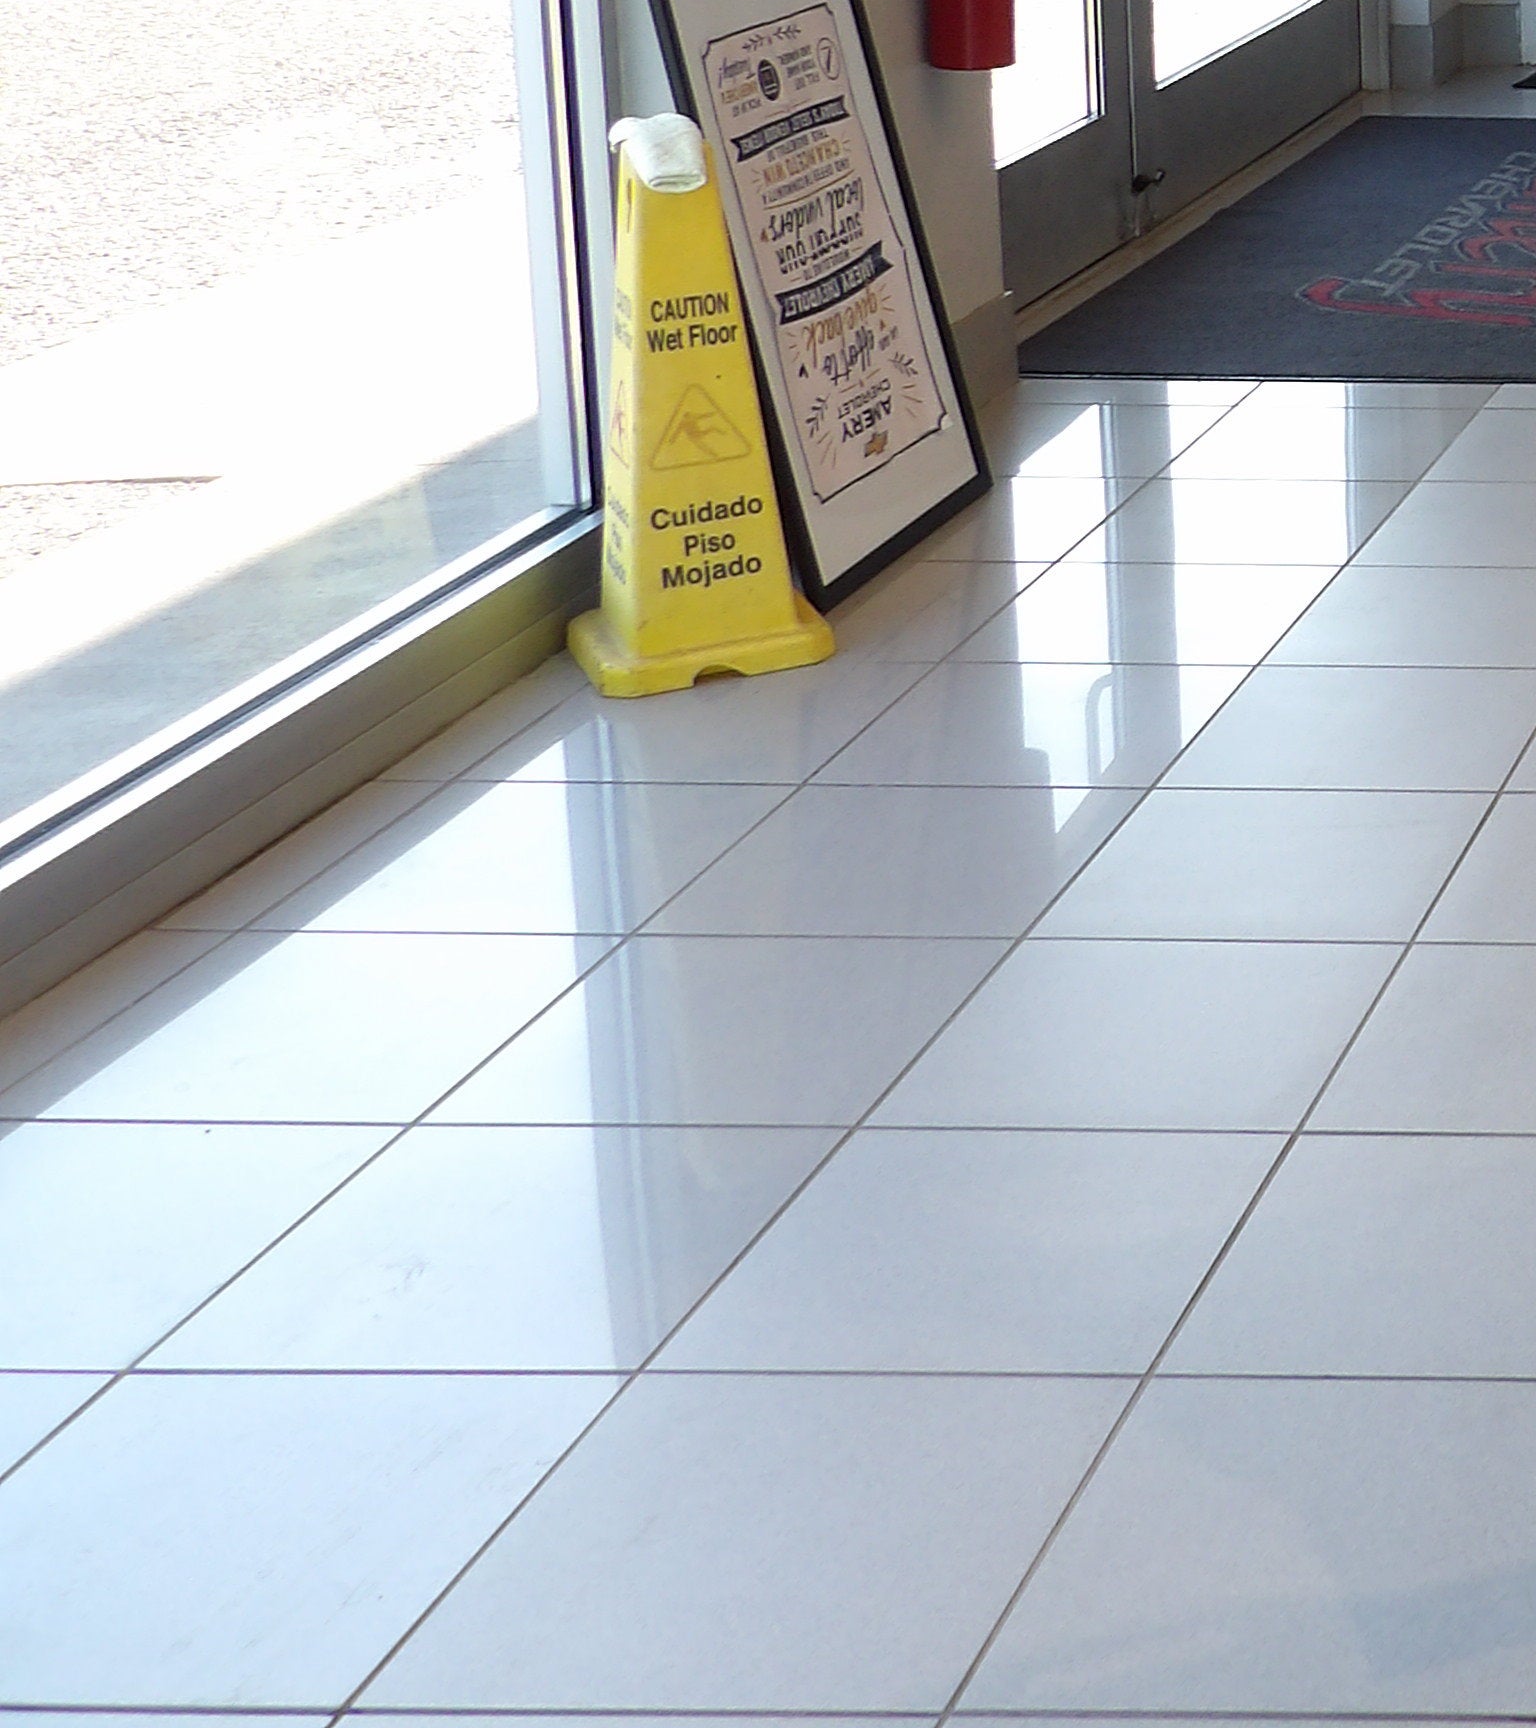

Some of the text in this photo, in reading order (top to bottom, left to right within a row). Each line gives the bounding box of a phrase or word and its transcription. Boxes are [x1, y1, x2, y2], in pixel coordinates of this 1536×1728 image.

[826, 177, 862, 226] local
[776, 213, 865, 274] SUPPORT OUR
[650, 292, 729, 323] CAUTION
[647, 324, 738, 354] Wet Floor
[803, 316, 847, 369] back
[837, 378, 891, 419] CHEVROLET
[842, 397, 892, 442] AMERY
[650, 495, 763, 531] Cuidado
[684, 532, 735, 557] Piso
[661, 554, 762, 590] Mojado
